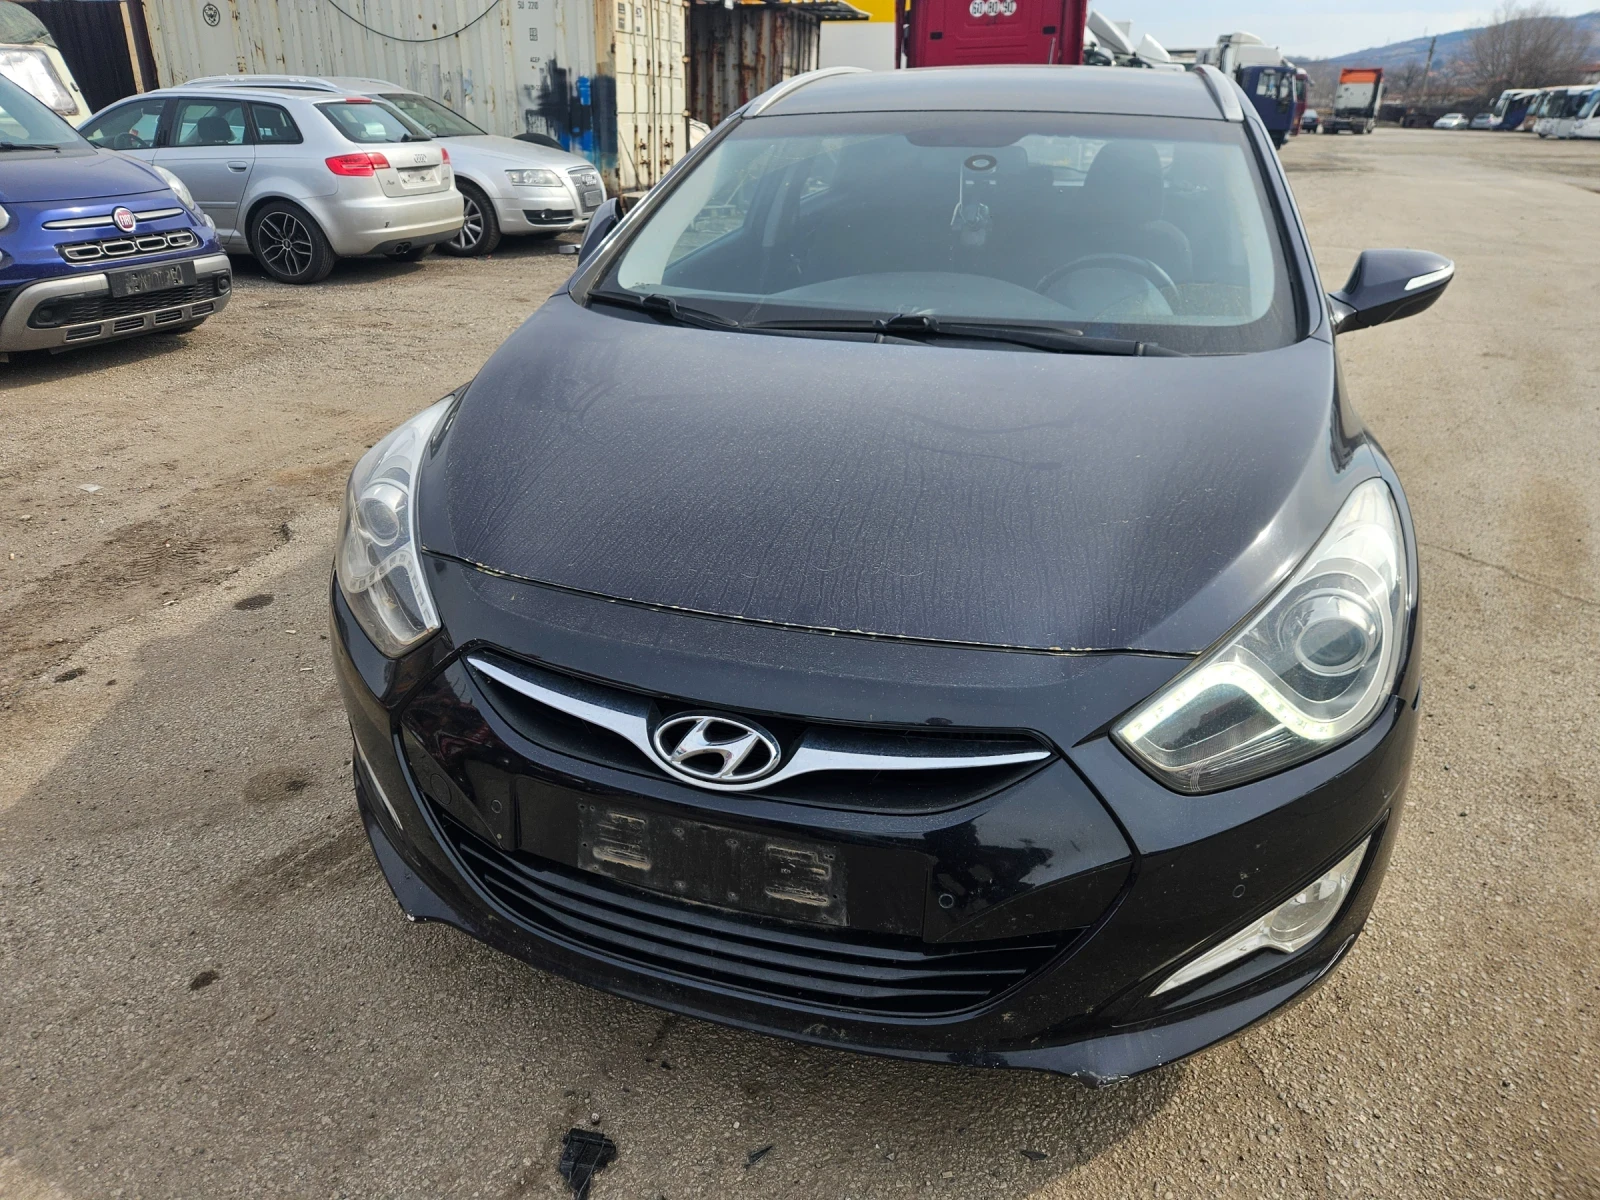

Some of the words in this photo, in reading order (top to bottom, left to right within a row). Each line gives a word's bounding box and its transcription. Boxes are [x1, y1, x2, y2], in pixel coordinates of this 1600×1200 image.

[972, 1, 982, 14] 60
[988, 1, 998, 14] 80
[119, 214, 133, 226] FIAT
